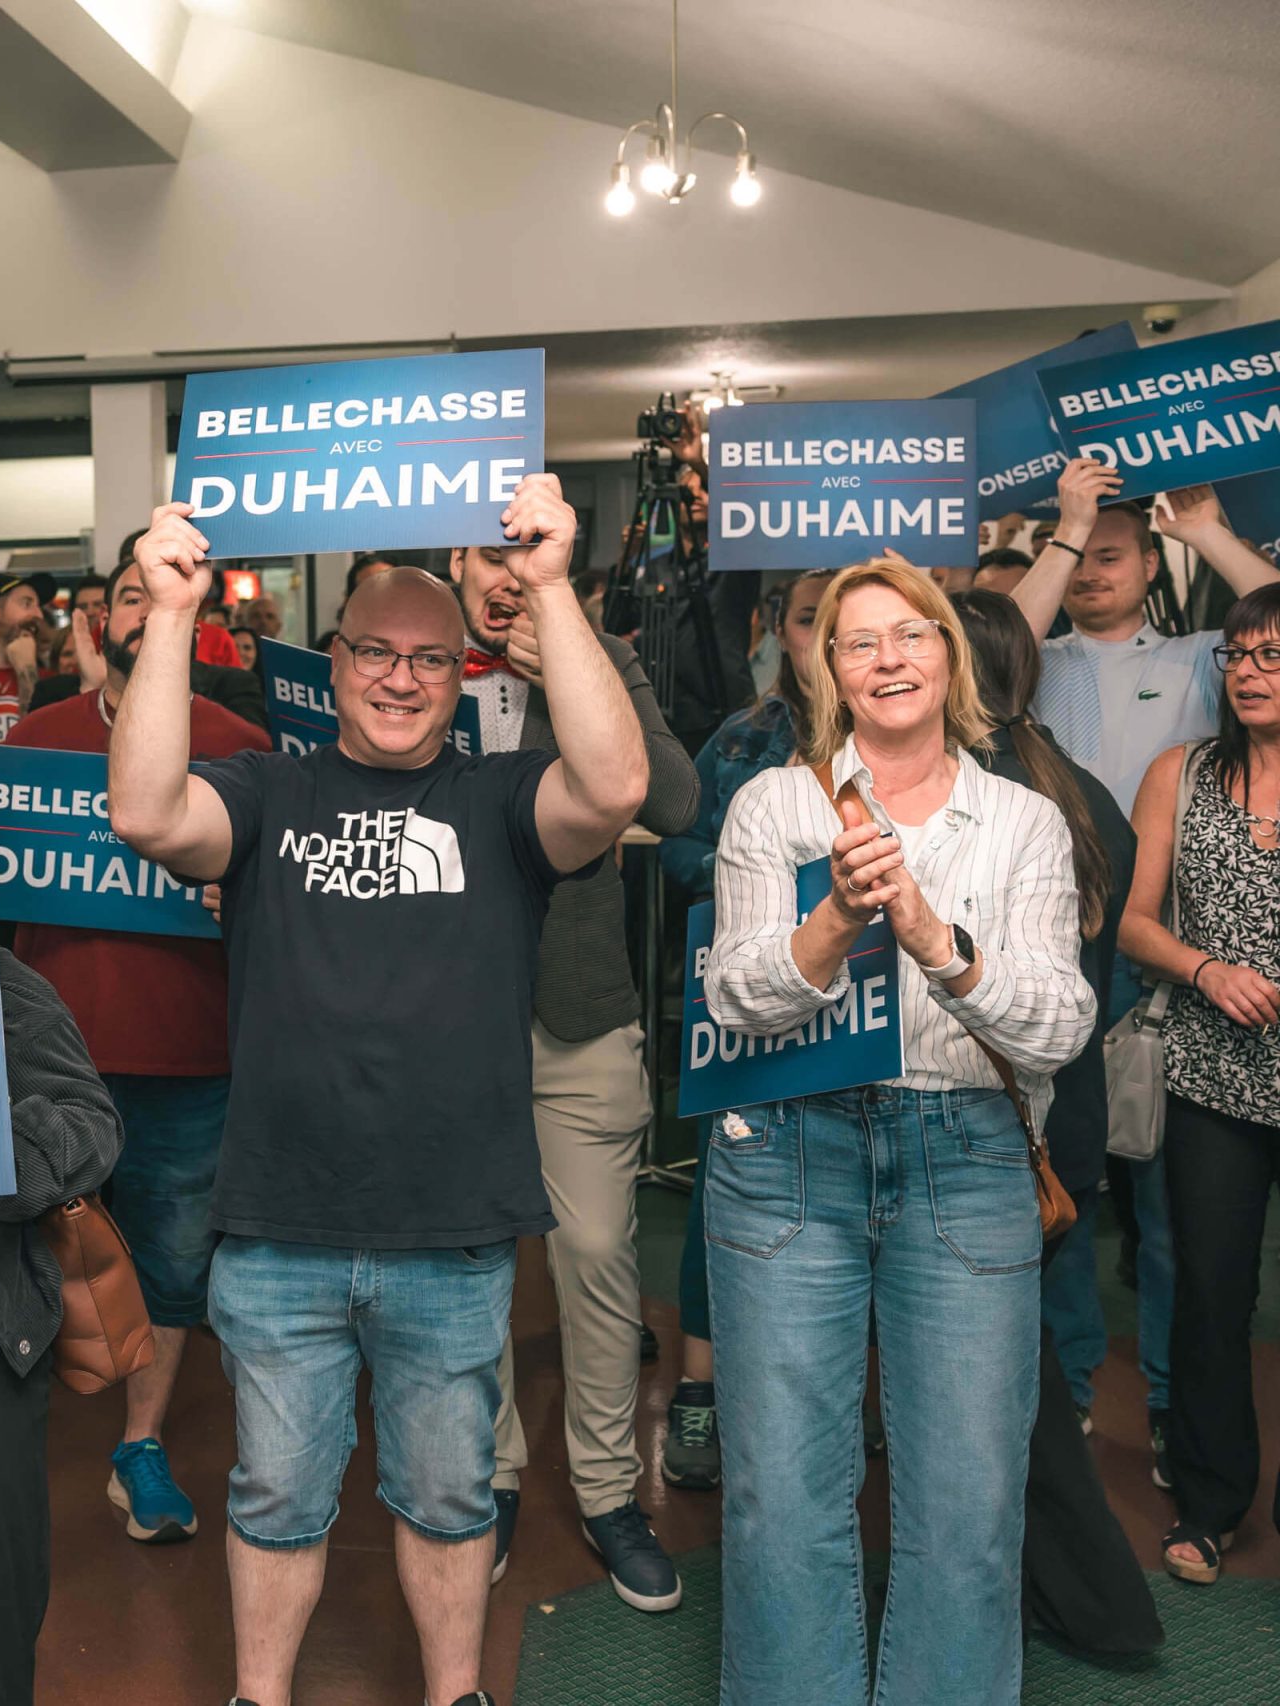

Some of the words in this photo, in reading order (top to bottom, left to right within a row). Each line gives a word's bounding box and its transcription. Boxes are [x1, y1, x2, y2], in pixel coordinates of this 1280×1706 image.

[196, 389, 526, 438] BELLECHASSE
[1167, 400, 1205, 416] AVEC
[329, 439, 383, 455] AVEC
[721, 437, 965, 467] BELLECHASSE
[1078, 403, 1280, 470] DUHAIM
[189, 458, 526, 519] DUHAIME
[821, 476, 861, 489] AVEC
[720, 497, 965, 538] DUHAIME
[337, 809, 406, 840] THE
[279, 828, 402, 870] NORTH
[305, 862, 399, 899] FACE
